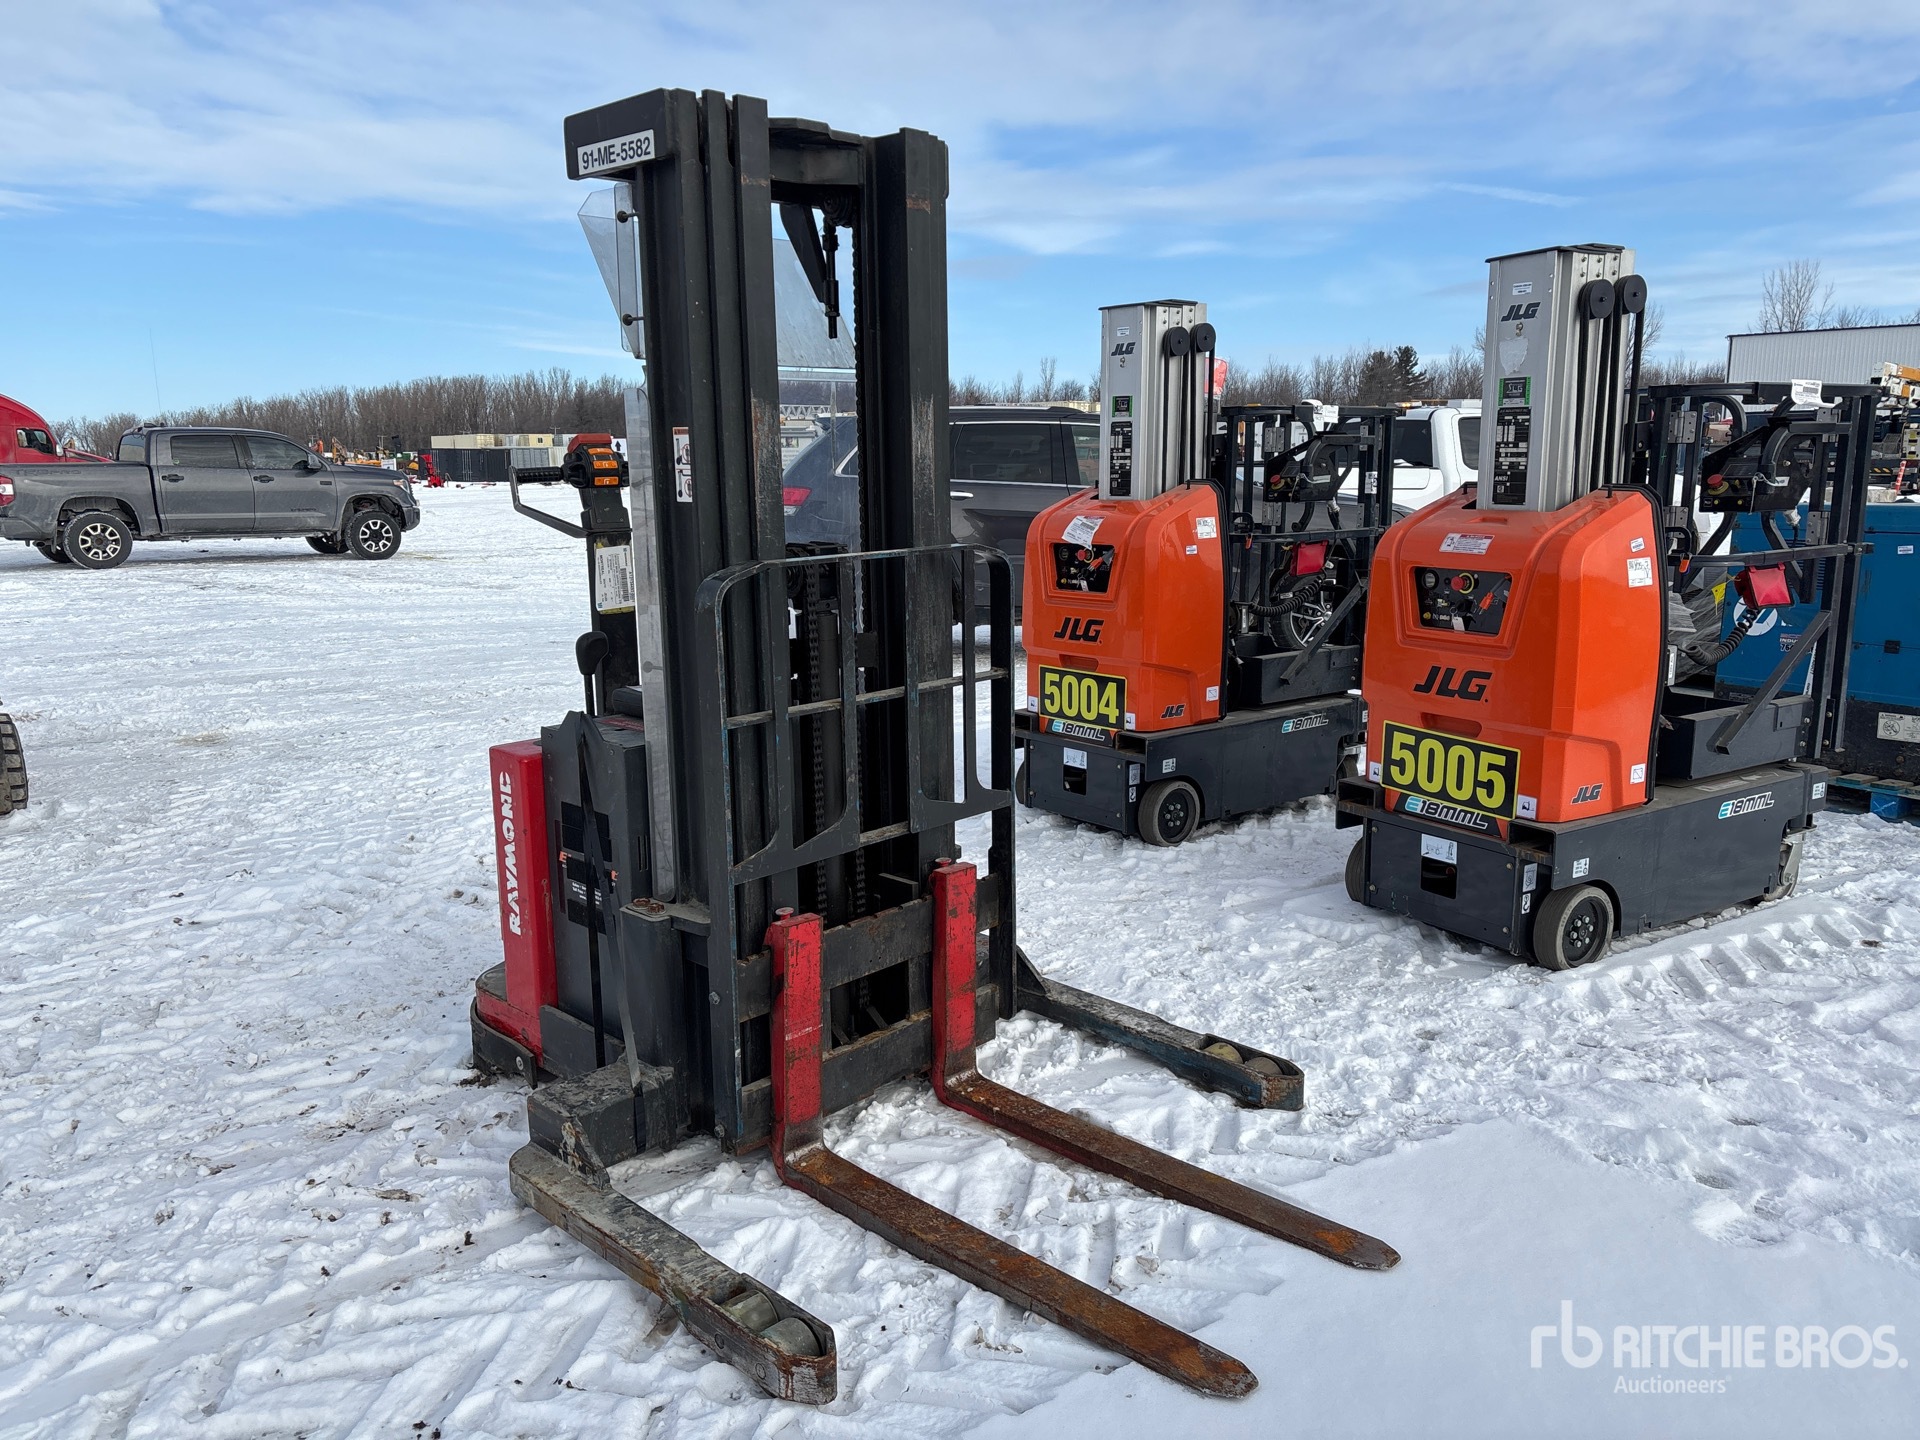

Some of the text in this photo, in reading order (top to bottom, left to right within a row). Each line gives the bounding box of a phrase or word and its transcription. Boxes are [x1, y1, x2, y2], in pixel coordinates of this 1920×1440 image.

[582, 136, 651, 170] 91-ME-5582
[1501, 302, 1541, 322] JLG
[1111, 342, 1135, 357] JLG
[1054, 617, 1104, 643] JLG
[1413, 666, 1493, 702] JLG
[1044, 672, 1119, 724] 5004
[1161, 704, 1185, 719] JLG
[1282, 713, 1329, 733] E18MML
[1052, 721, 1106, 741] E18MML
[1390, 731, 1506, 809] 5005
[1572, 784, 1602, 804] JLG
[1718, 792, 1775, 819] E18MML
[1405, 797, 1488, 830] E18MML
[500, 771, 521, 936] RAYMOND
